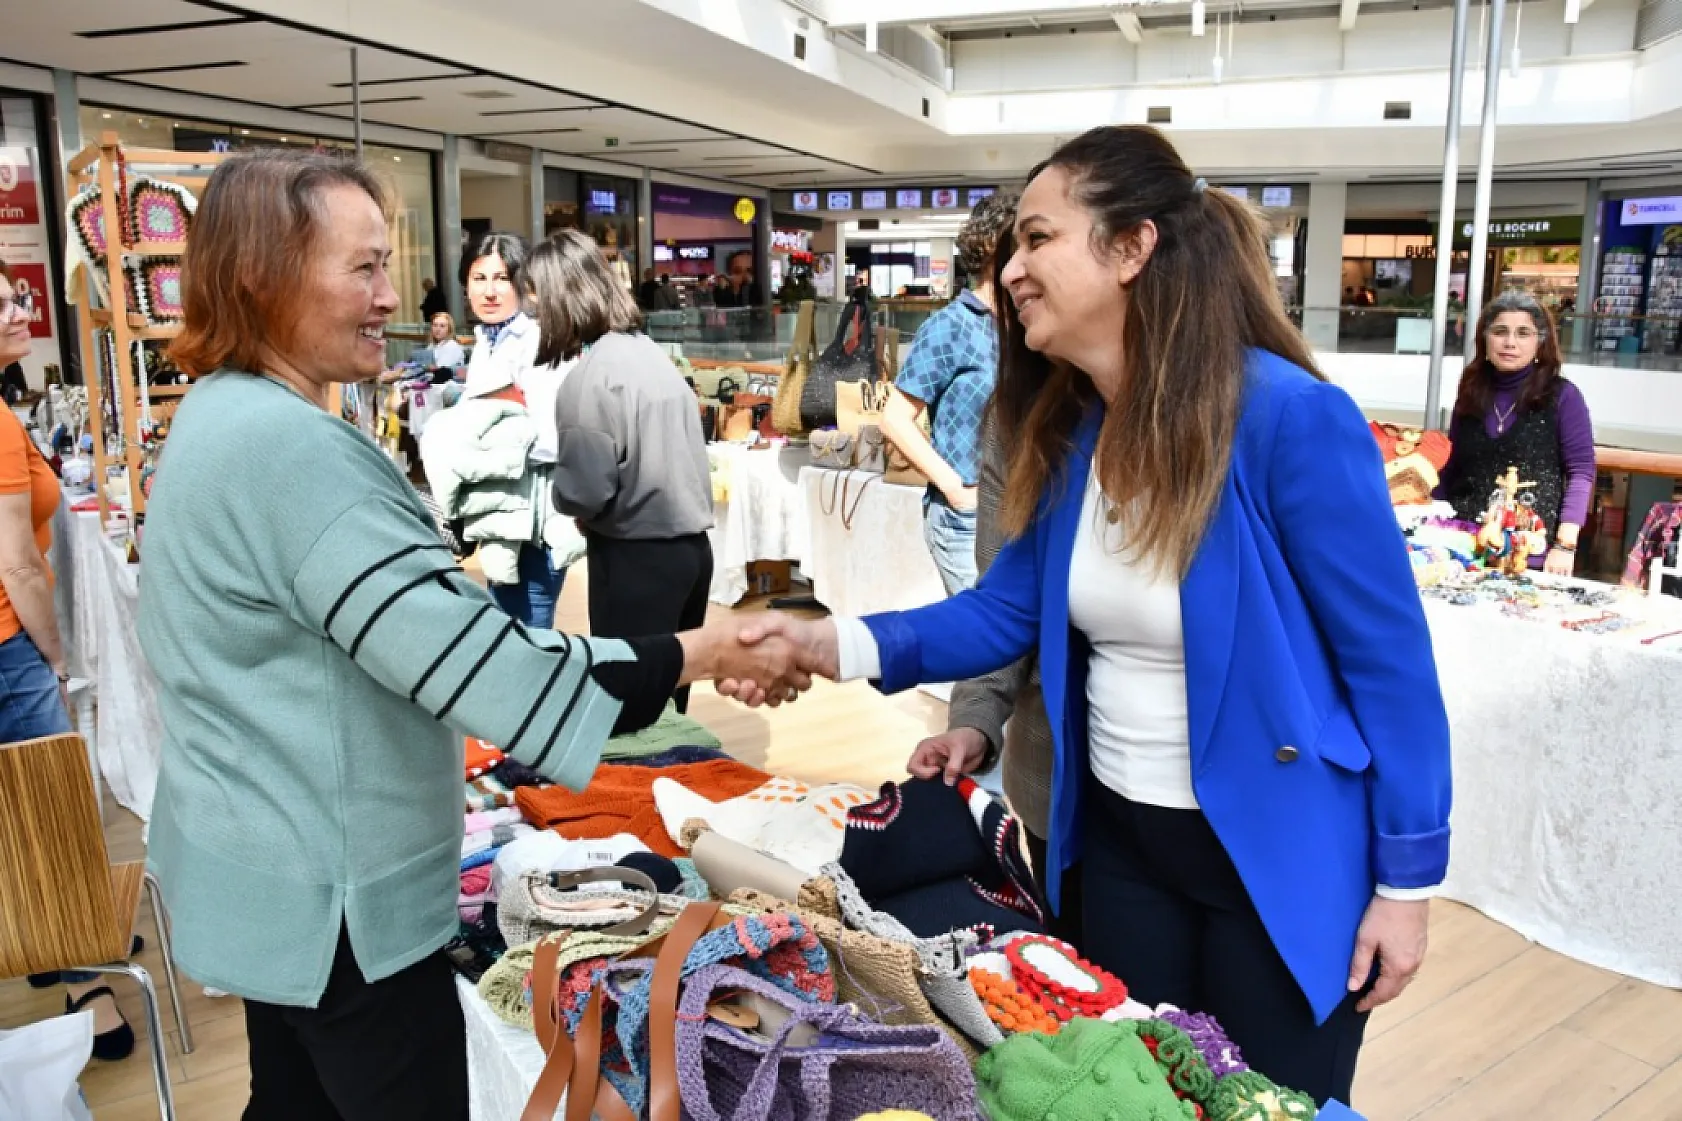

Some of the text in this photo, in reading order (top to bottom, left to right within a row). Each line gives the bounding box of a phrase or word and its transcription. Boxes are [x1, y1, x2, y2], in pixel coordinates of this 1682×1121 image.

[0, 203, 24, 218] rim
[1504, 221, 1550, 232] ROCHER
[1406, 245, 1436, 258] BUR
